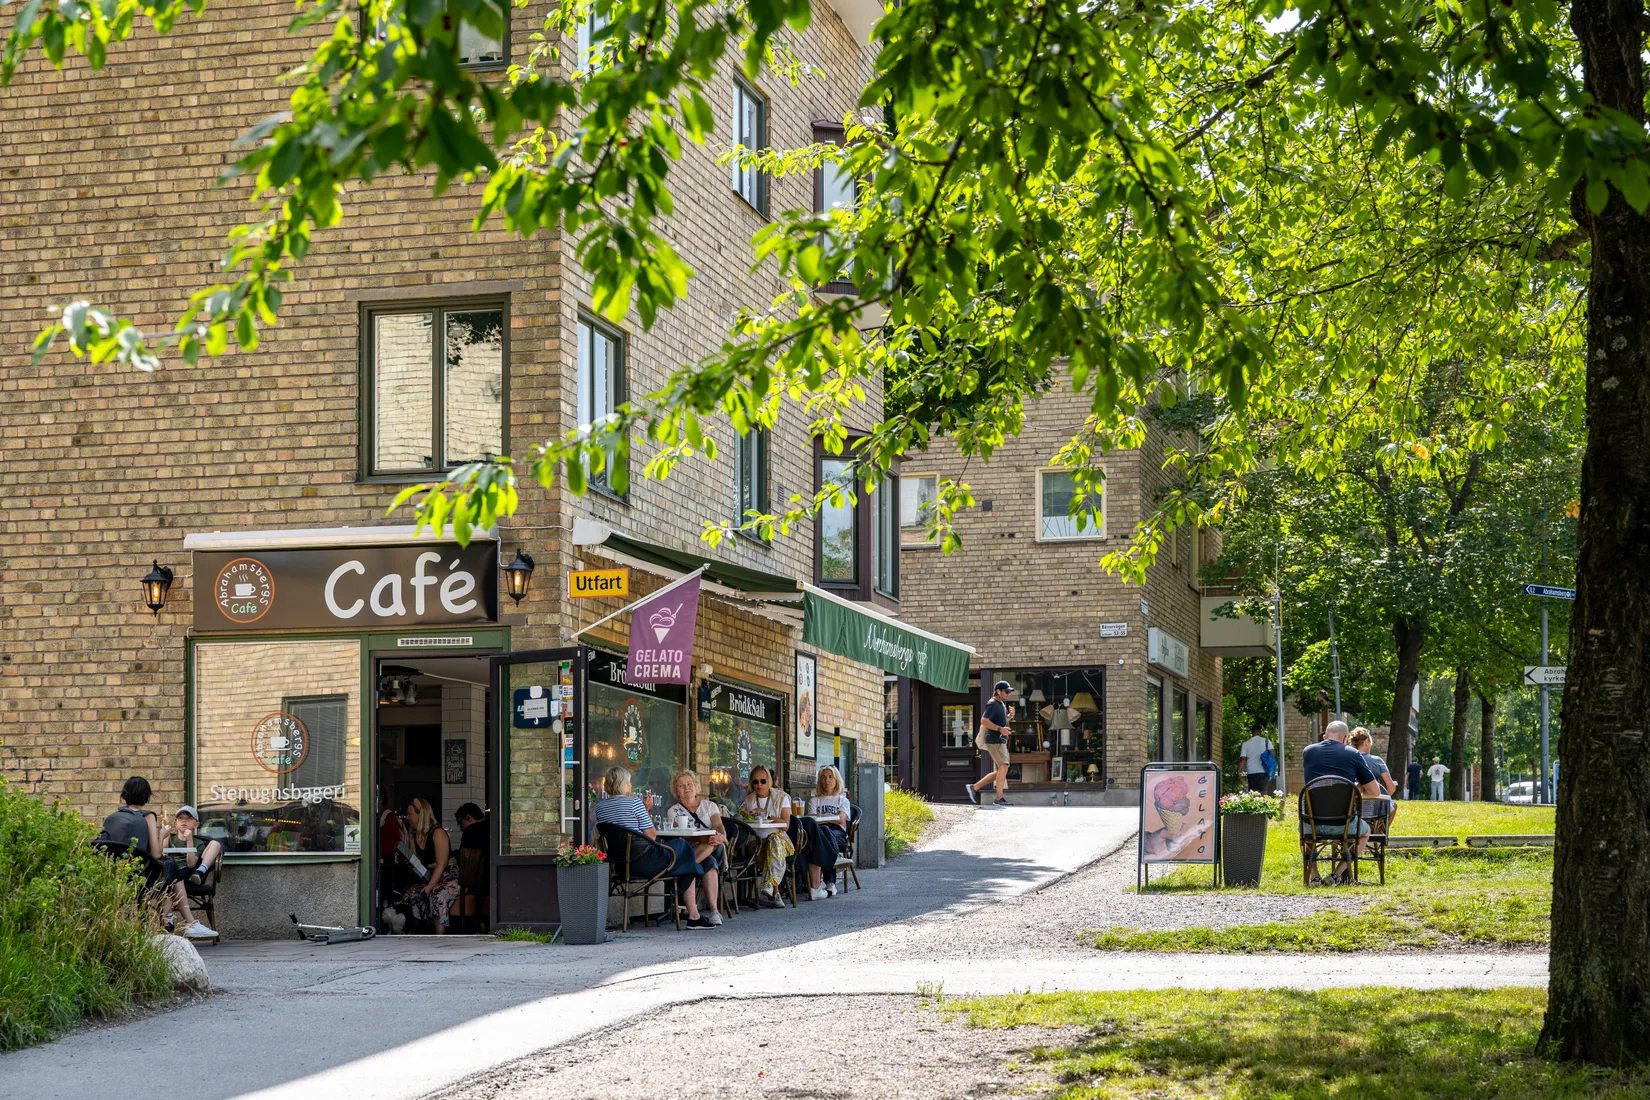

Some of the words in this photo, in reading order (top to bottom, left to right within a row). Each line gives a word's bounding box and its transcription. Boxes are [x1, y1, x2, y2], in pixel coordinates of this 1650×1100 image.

[219, 563, 270, 607] Abrahamsbergs
[324, 551, 478, 619] Café
[576, 575, 622, 591] Utfart
[231, 602, 257, 614] Café
[636, 649, 683, 663] GELATO
[634, 664, 681, 678] CREMA
[729, 692, 766, 719] Bröd&Salt
[256, 717, 303, 758] Abrahamsbergs
[210, 783, 346, 804] Stenugnsbageri
[1197, 776, 1207, 854] GELATO
